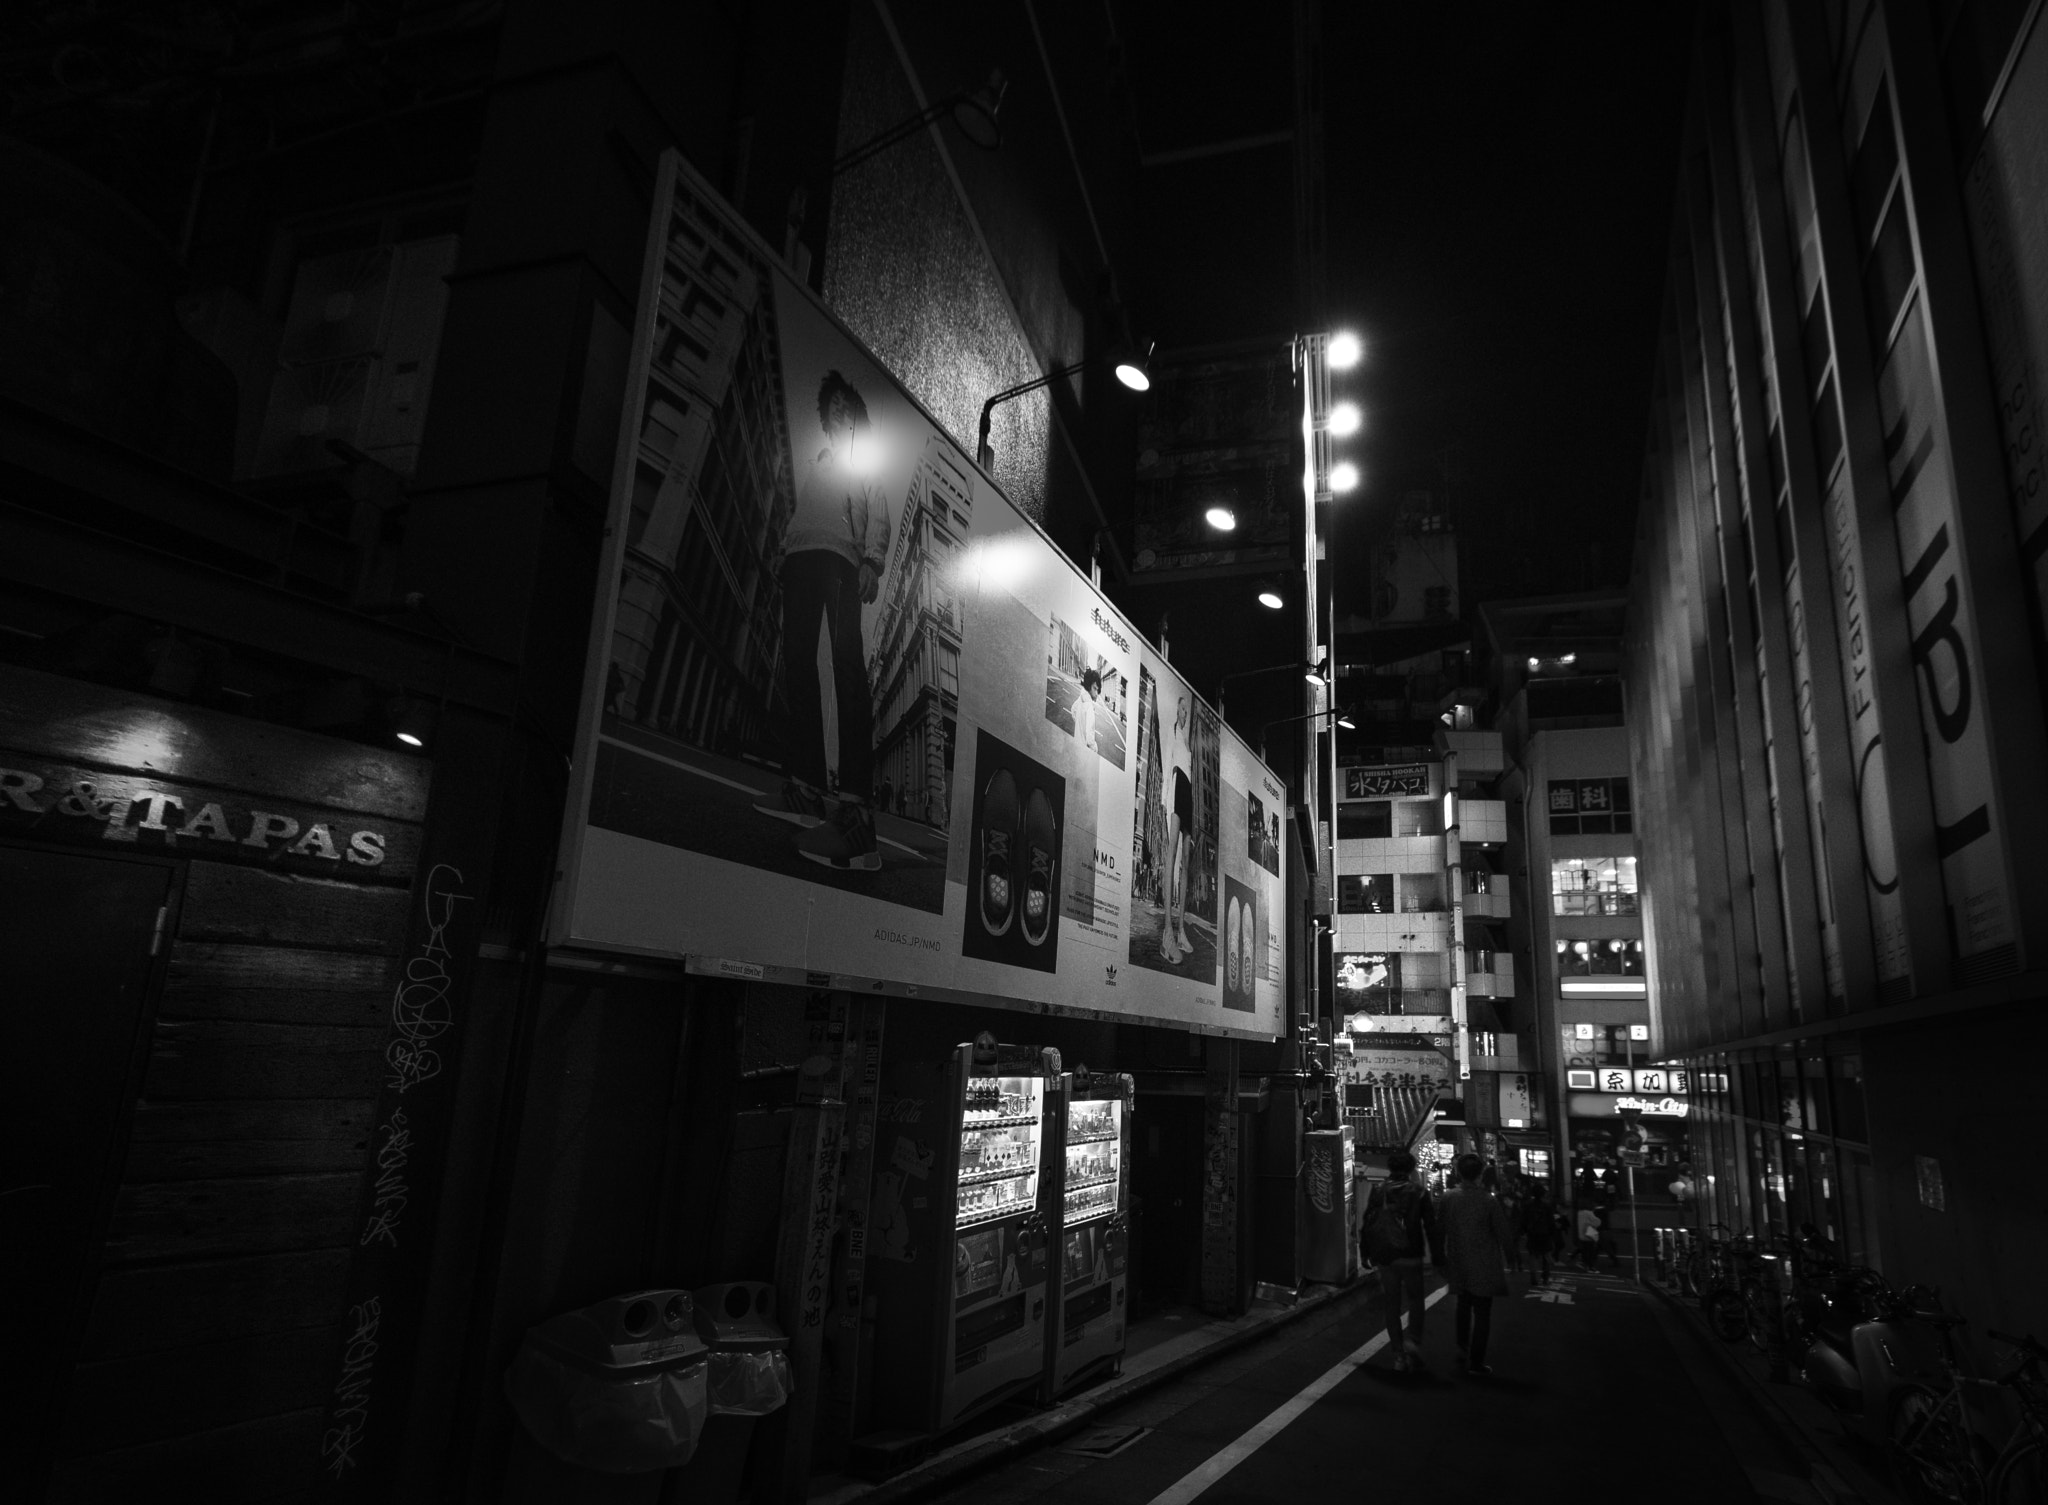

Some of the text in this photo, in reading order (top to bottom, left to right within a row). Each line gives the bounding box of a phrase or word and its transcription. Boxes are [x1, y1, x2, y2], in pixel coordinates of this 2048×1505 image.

[1350, 772, 1421, 796] 水タバコ
[1364, 767, 1426, 777] SHISHA HOOKAH
[1550, 786, 1608, 810] 歯科
[57, 780, 111, 821] &
[130, 789, 386, 867] TAPAS
[873, 929, 942, 952] ADIDAS.JP/NMD
[851, 1230, 864, 1257] BNE
